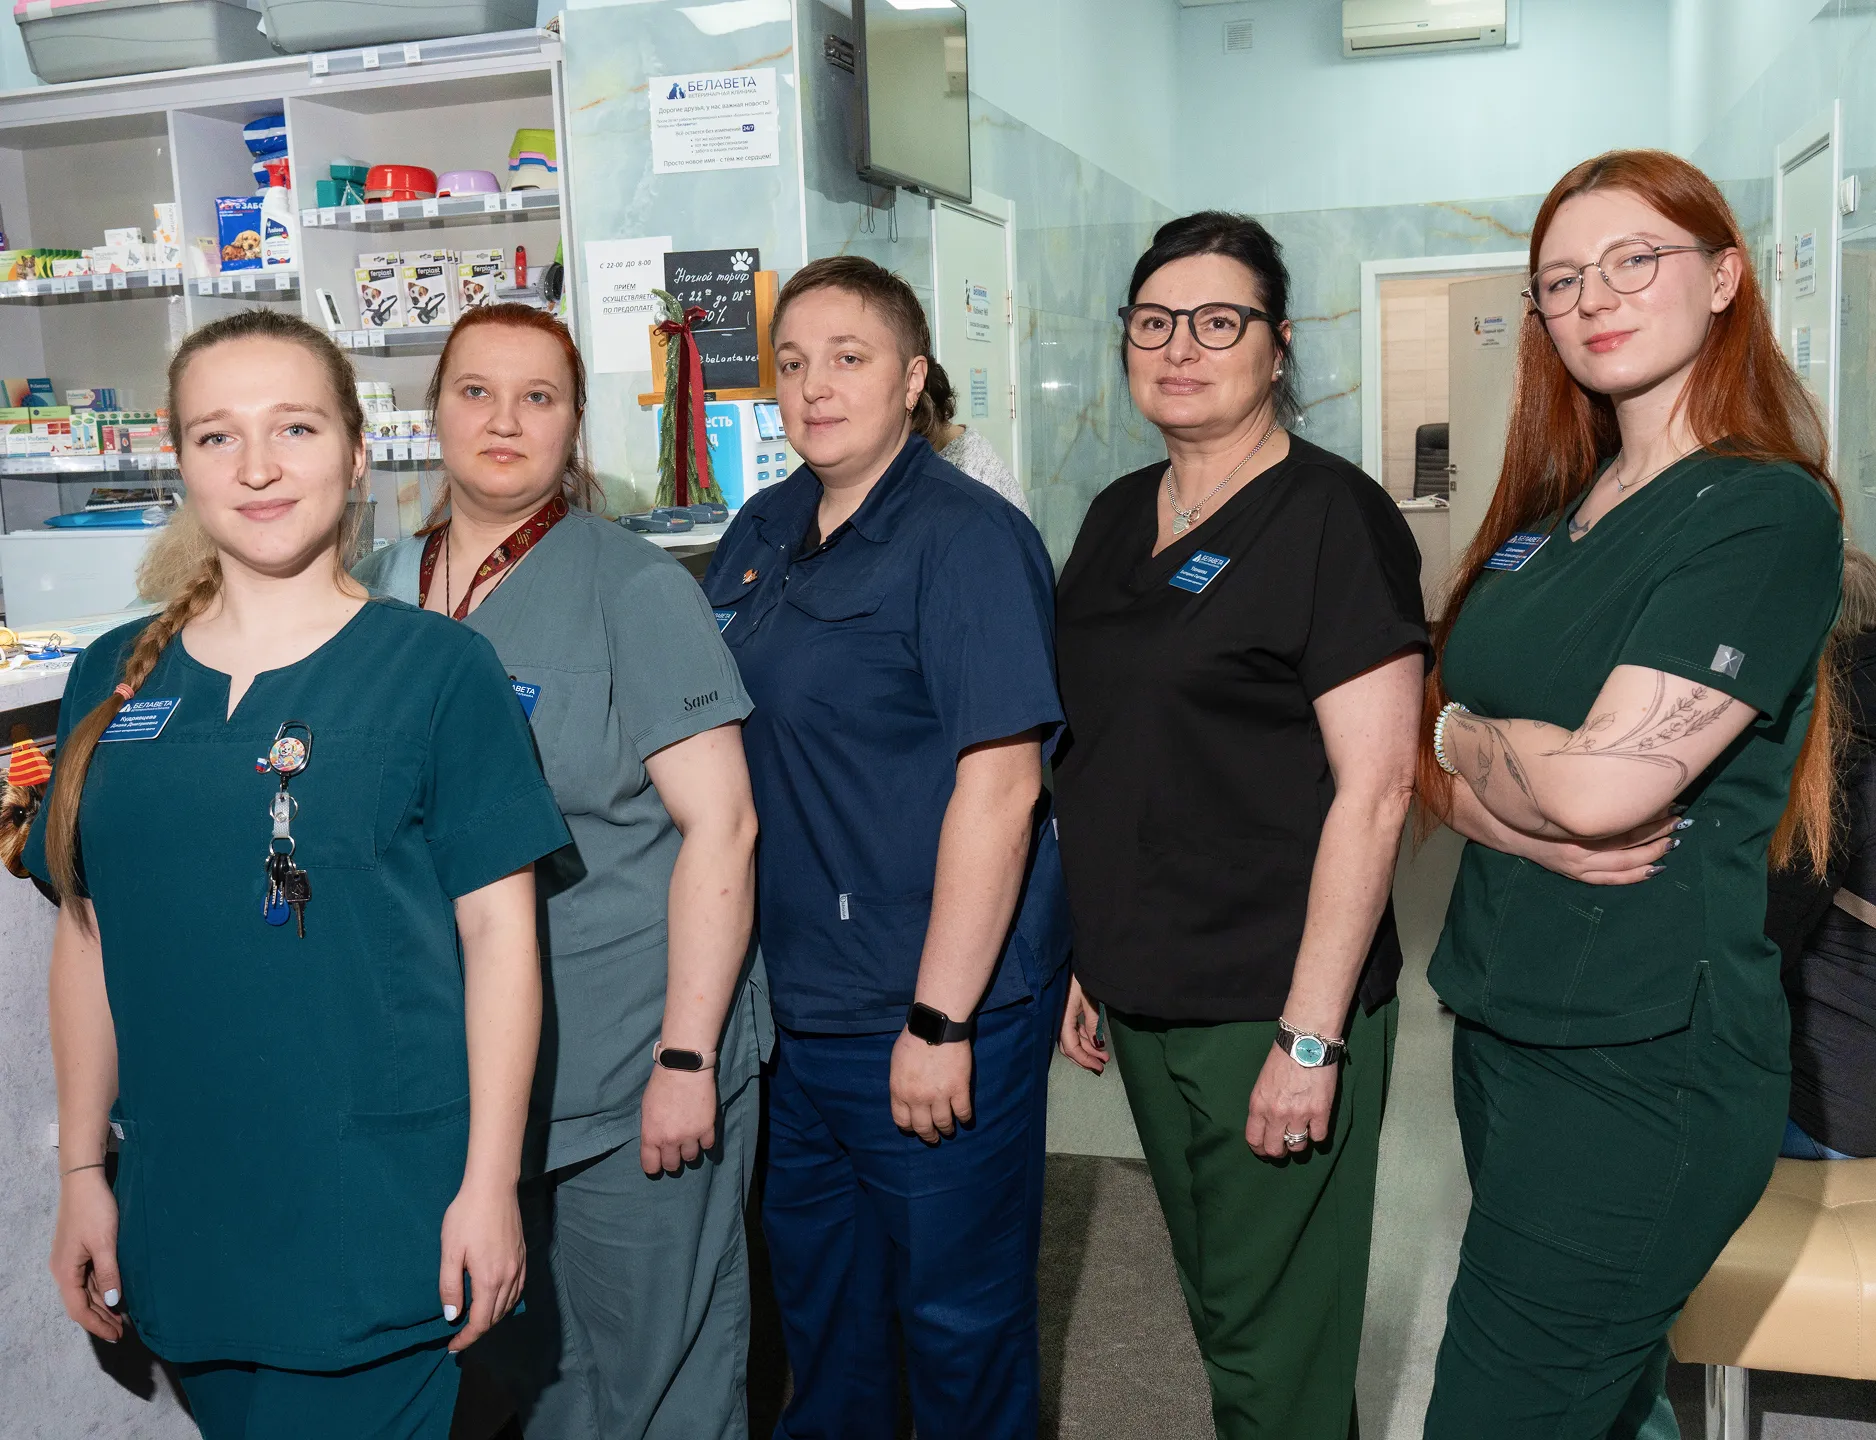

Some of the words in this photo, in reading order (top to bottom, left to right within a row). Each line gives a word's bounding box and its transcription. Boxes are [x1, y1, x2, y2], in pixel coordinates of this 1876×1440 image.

[688, 76, 756, 92] БЕЛАВЕТА
[744, 153, 772, 162] сердцем!
[370, 268, 392, 279] ferplast
[417, 266, 441, 277] ferplast
[674, 268, 713, 284] Ночной
[716, 272, 750, 284] тариф
[602, 293, 658, 303] ОСУЩЕСТВЛЯЕТСЯ
[712, 295, 728, 308] до
[614, 304, 654, 314] ПРЕДОПЛАТЕ
[705, 416, 734, 428] есть
[132, 700, 173, 709] БЕЛАВЕТА
[684, 690, 719, 712] Sana
